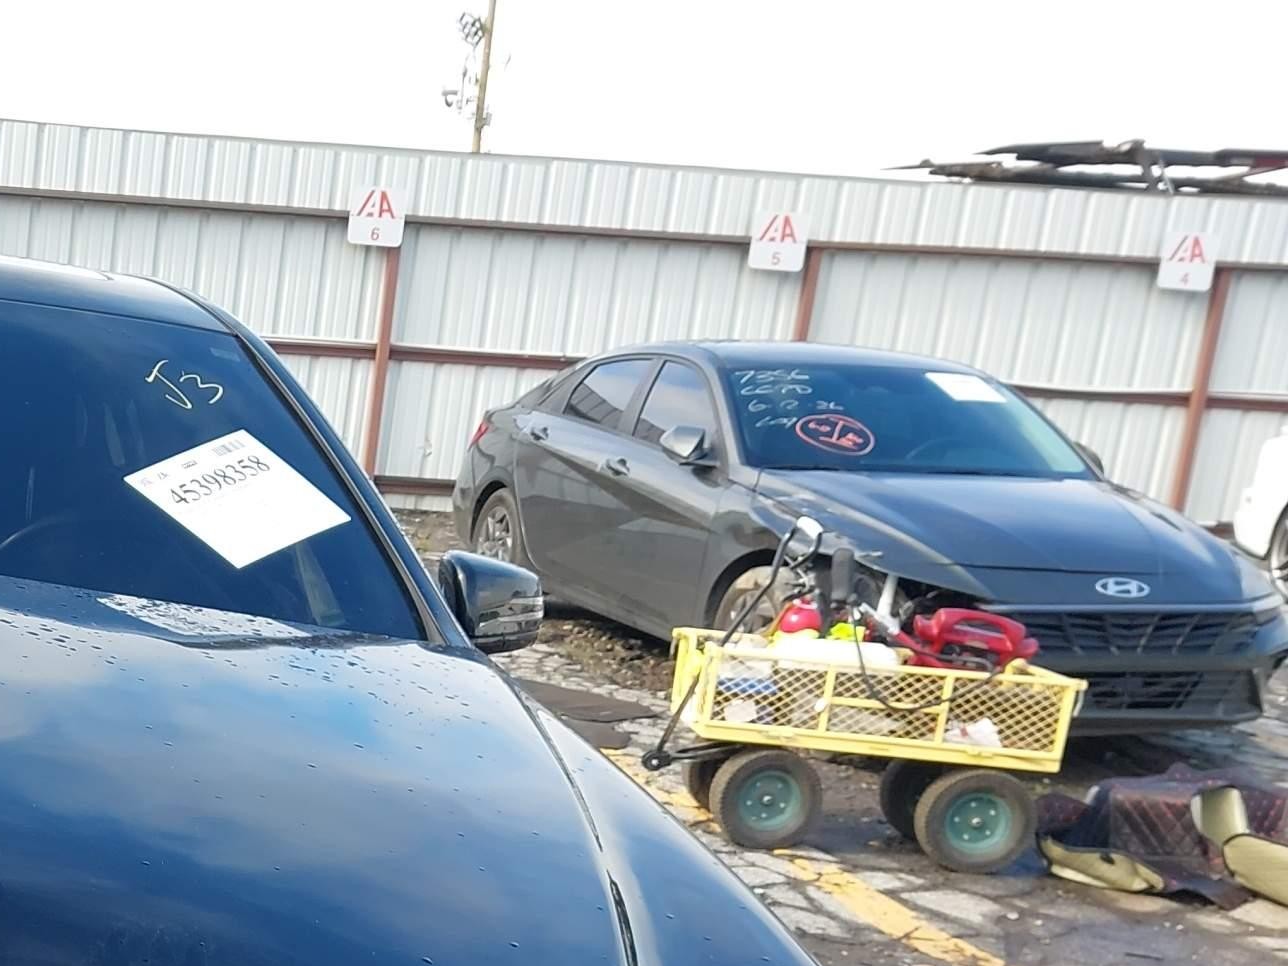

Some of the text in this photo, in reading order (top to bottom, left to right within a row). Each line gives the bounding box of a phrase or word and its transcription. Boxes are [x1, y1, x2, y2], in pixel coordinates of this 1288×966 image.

[370, 227, 380, 241] 6
[771, 251, 782, 266] 5
[1179, 272, 1190, 286] 4
[170, 455, 271, 505] 45398358
